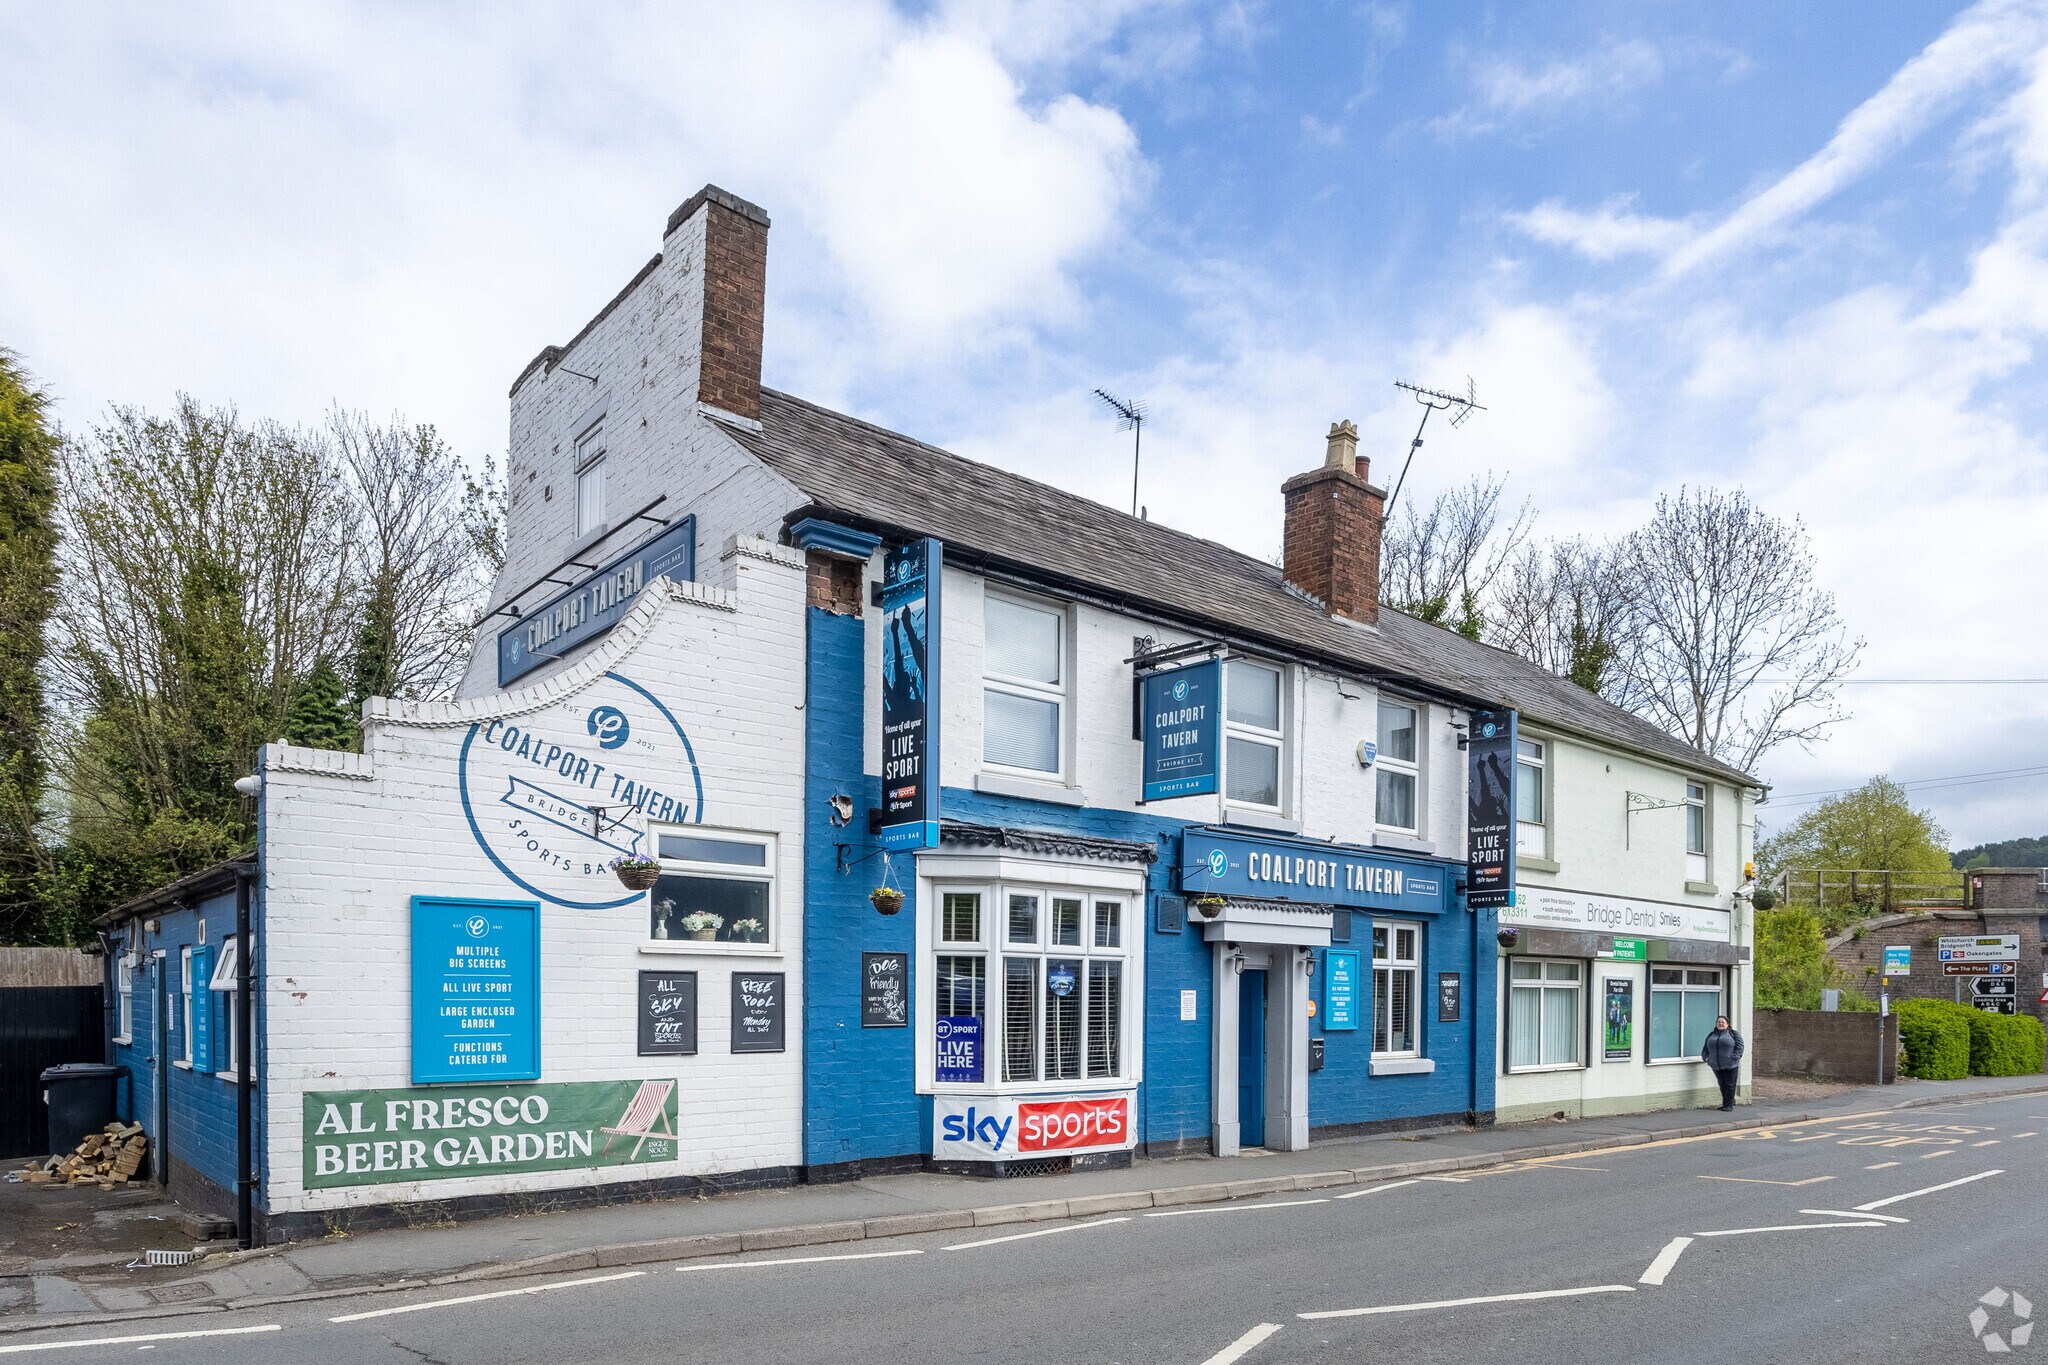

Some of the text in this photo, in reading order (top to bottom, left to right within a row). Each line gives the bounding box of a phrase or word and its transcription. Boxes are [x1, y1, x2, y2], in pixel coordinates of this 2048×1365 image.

[653, 558, 671, 573] SPORTS
[527, 559, 644, 653] COALPORT TAVERN
[1155, 705, 1206, 728] COALPORT
[562, 703, 656, 751] EST. 2021
[884, 725, 898, 734] Home
[898, 721, 904, 733] of
[911, 719, 922, 730] your
[891, 734, 914, 757] LIVE
[1162, 729, 1198, 749] TAVERN
[484, 719, 690, 824] COALPORT TAVERN
[886, 755, 919, 780] SPORT
[889, 786, 915, 799] sky sports
[1159, 781, 1199, 792] SPORTS BAR
[900, 800, 913, 809] Sport
[885, 831, 920, 843] SPORTS BAR
[1477, 835, 1500, 849] LIVE
[508, 818, 607, 875] SPORTS BA
[1472, 849, 1505, 863] SPORT
[1247, 851, 1403, 895] COALPORT TAVERN
[1515, 894, 1526, 905] 52
[1502, 907, 1528, 918] 613311
[1587, 902, 1681, 928] Bridge Dental Smiles
[456, 946, 500, 956] MULTIPLE
[1615, 941, 1635, 949] WELCOME
[1617, 950, 1636, 958] PATIENTS
[449, 958, 507, 969] BIG SCREENS
[872, 959, 899, 974] DOG
[443, 983, 513, 993] ALL LIVE SPORT
[657, 979, 677, 992] ALL
[741, 979, 775, 994] FREE
[870, 976, 899, 990] friendly
[651, 996, 683, 1014] SKY
[740, 994, 775, 1008] POOL
[440, 1006, 515, 1016] LARGE ENCLOSED
[461, 1018, 495, 1029] GARDEN
[654, 1022, 683, 1033] TNT
[743, 1016, 771, 1028] Monday
[654, 1032, 682, 1040] SPORTS
[953, 1025, 978, 1034] SPORT
[454, 1042, 503, 1053] FUNCTIONS
[938, 1041, 974, 1055] LIVE
[449, 1054, 507, 1065] CATERED FOR
[938, 1056, 974, 1068] HERE
[315, 1095, 549, 1136] AL FRESCO
[943, 1106, 1121, 1152] sky sports
[1837, 1122, 1995, 1134] BUS
[1731, 1130, 1964, 1148] STOP
[315, 1129, 594, 1176] BEER GARDEN
